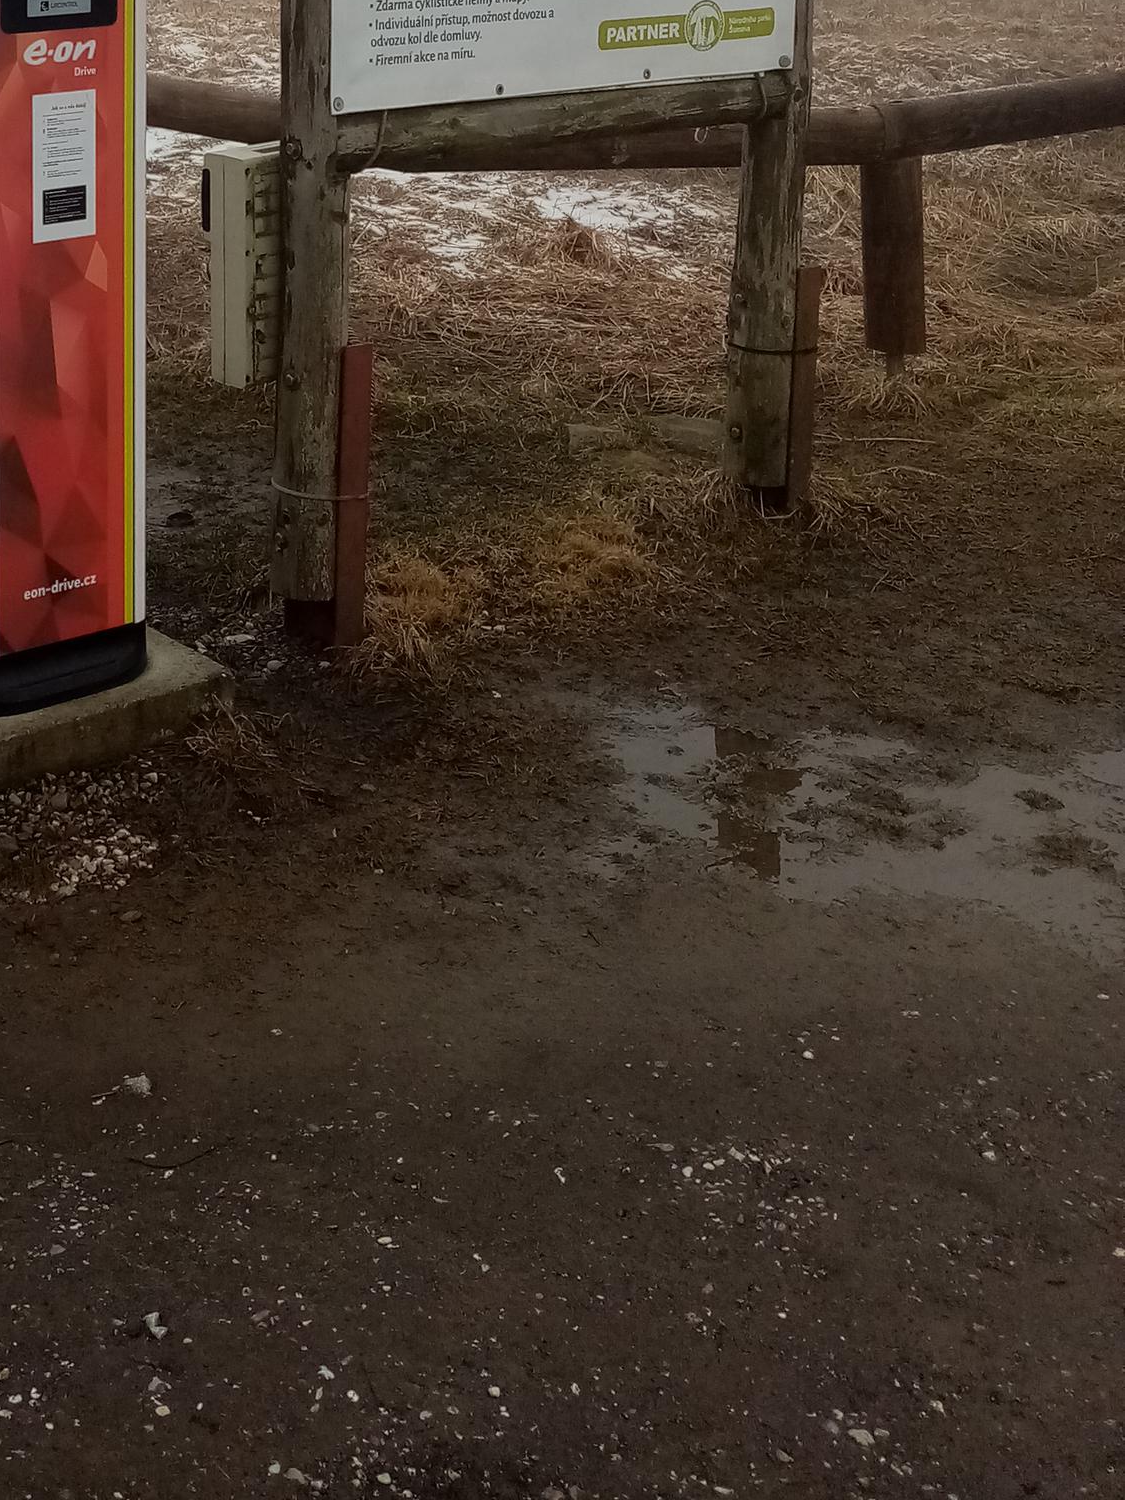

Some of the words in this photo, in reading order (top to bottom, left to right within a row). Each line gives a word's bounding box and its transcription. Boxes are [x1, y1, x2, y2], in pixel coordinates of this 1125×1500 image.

[375, 15, 433, 31] Individuální
[435, 13, 470, 28] přístup,
[472, 10, 511, 23] možnost
[513, 8, 546, 21] dovozu
[548, 9, 554, 18] a
[371, 33, 406, 48] odvozu
[407, 31, 422, 45] kol
[424, 31, 438, 43] dle
[440, 28, 483, 42] domluvy.
[606, 22, 681, 44] PARTNER
[375, 52, 412, 66] Firemní
[414, 50, 435, 63] akce
[437, 51, 449, 61] na
[451, 47, 476, 60] míru.
[74, 66, 96, 77] Drive
[23, 574, 97, 600] eon-drive.cz
